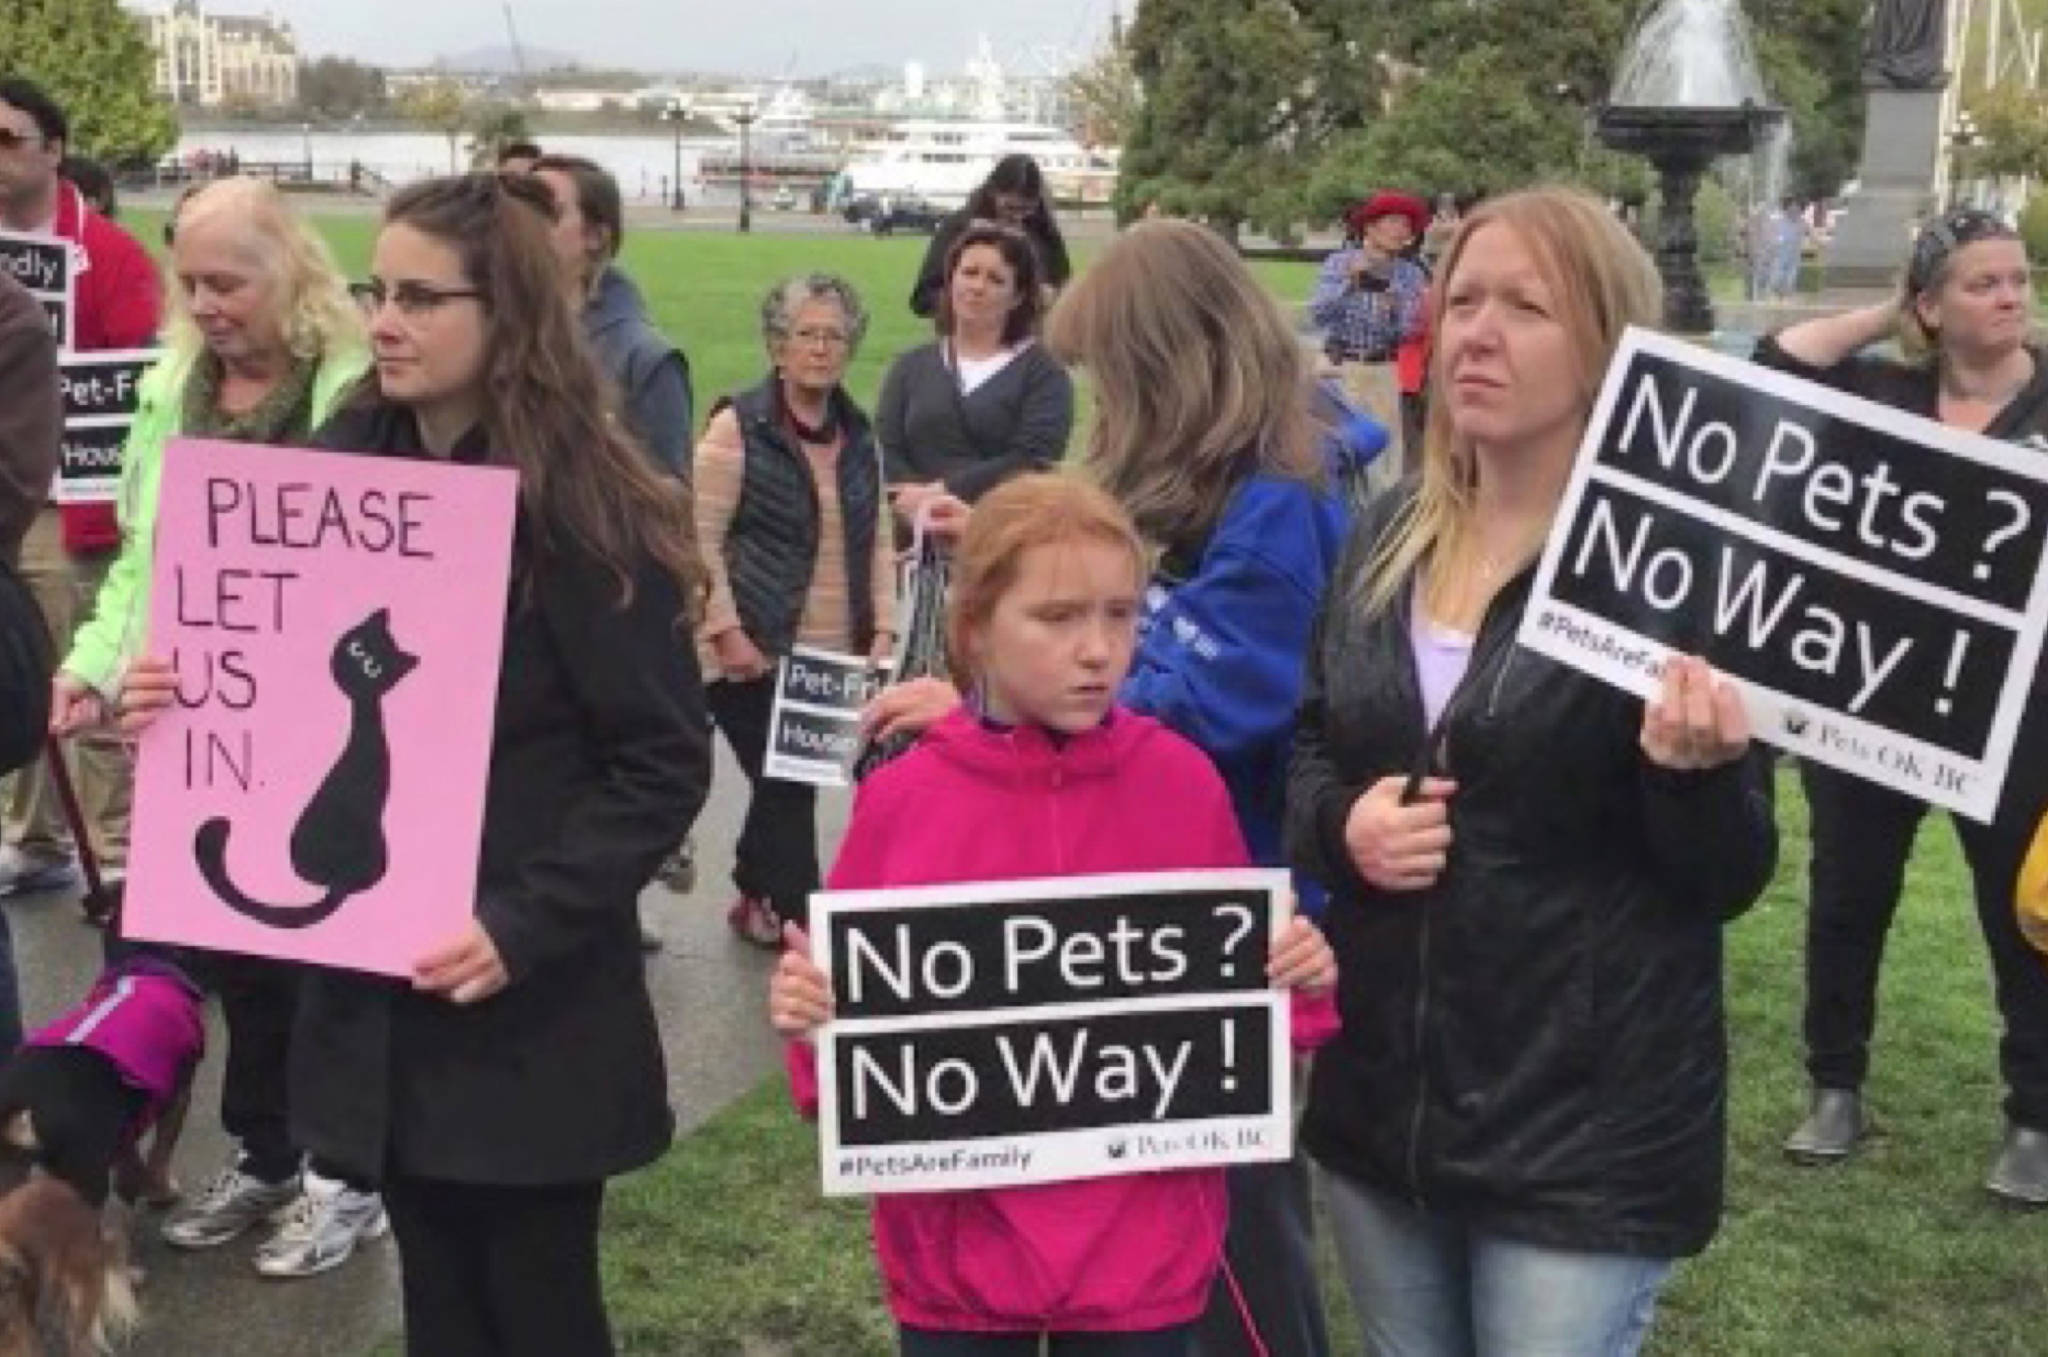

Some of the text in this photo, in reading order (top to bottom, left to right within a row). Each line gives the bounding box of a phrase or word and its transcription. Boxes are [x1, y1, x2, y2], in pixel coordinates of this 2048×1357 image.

[1617, 373, 1737, 485] No
[1753, 419, 1945, 559] Pets
[206, 477, 435, 560] PLEASE
[175, 565, 300, 634] LET
[1574, 498, 1694, 610] No
[1713, 545, 1914, 714] Way
[171, 646, 257, 709] US
[184, 727, 266, 792] IN.
[845, 922, 976, 1003] No
[1003, 914, 1188, 994] Pets
[851, 1042, 980, 1120] No
[996, 1027, 1193, 1120] Way
[839, 1144, 1031, 1177] #PetsAreFamily
